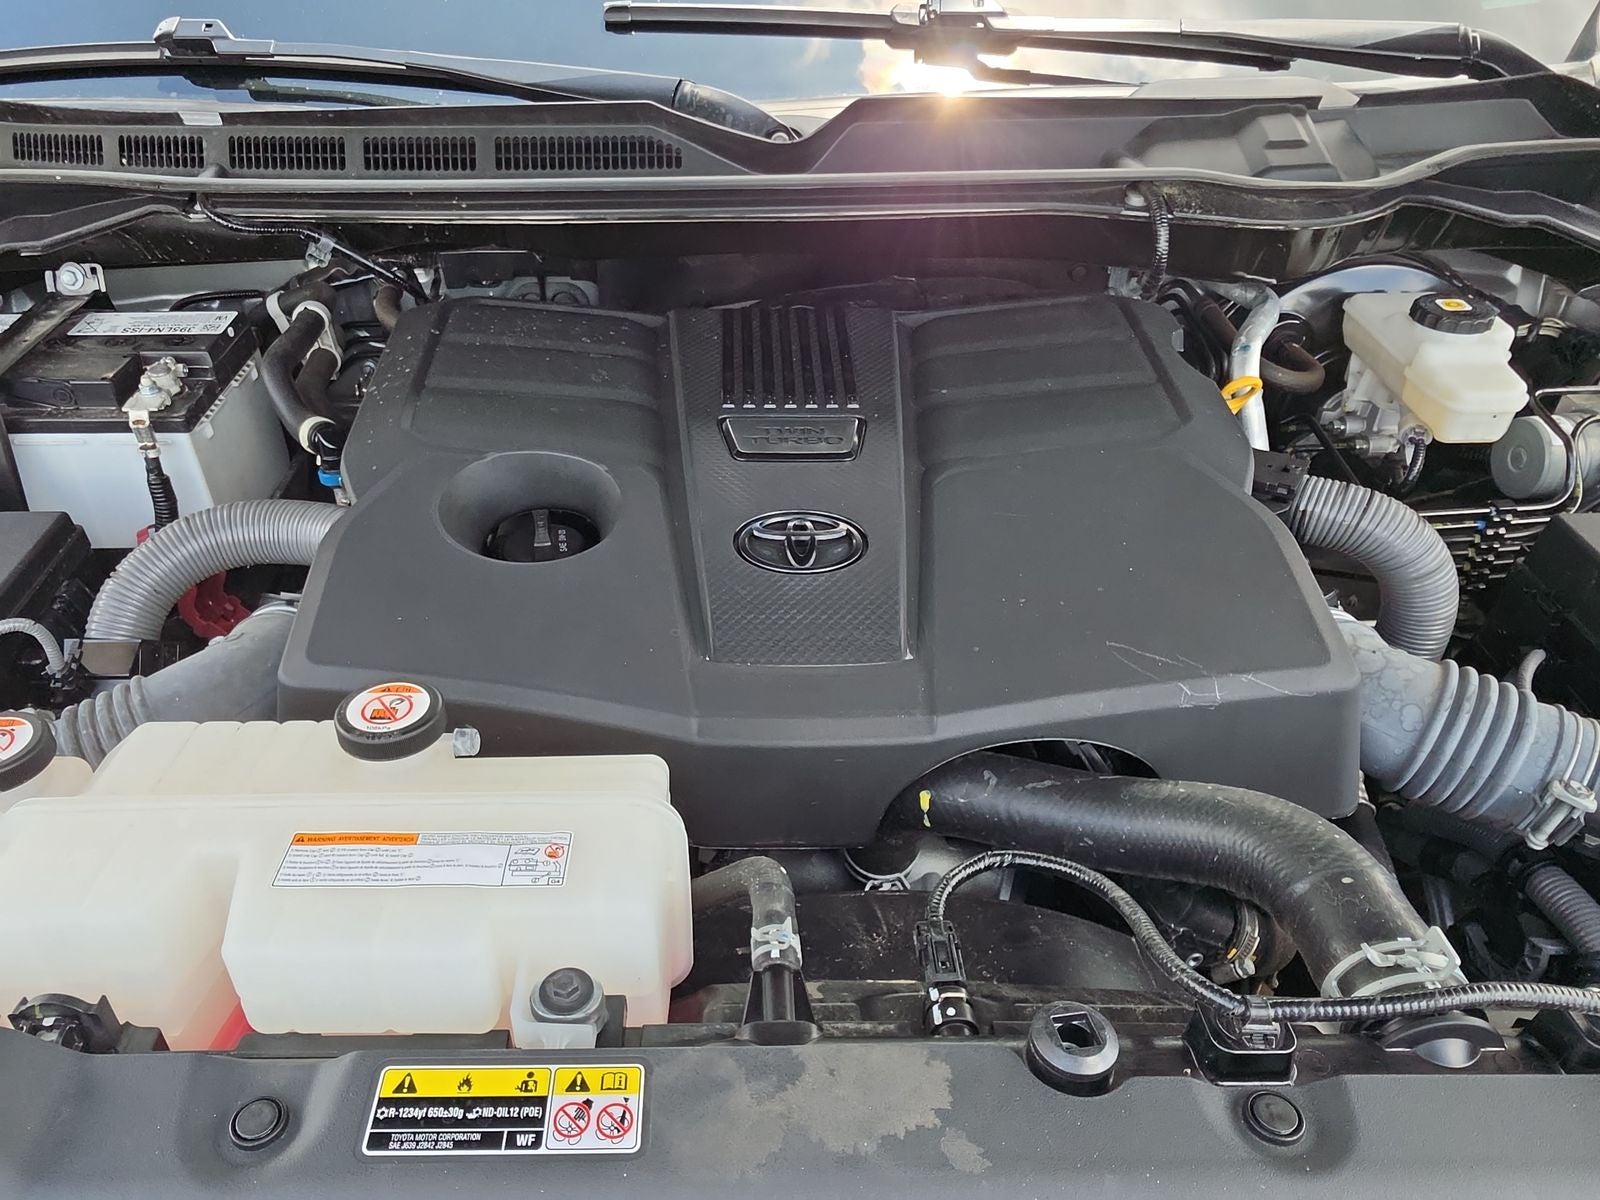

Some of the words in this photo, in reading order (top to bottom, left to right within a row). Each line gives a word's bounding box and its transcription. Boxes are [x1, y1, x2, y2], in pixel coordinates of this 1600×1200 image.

[746, 435, 844, 445] TURBO
[388, 1107, 428, 1120] R-1234yf
[427, 1106, 464, 1119] 650±30g
[482, 1106, 519, 1118] ND-OIL12
[520, 1106, 543, 1119] (POE)
[391, 1133, 415, 1141] TOYOTA
[415, 1133, 437, 1141] MOTOR
[438, 1132, 482, 1141] CORPORATION
[516, 1133, 537, 1147] WF
[388, 1141, 402, 1150] SAE
[401, 1141, 417, 1150] J639
[416, 1141, 435, 1150] J2842
[435, 1141, 454, 1150] J2845
